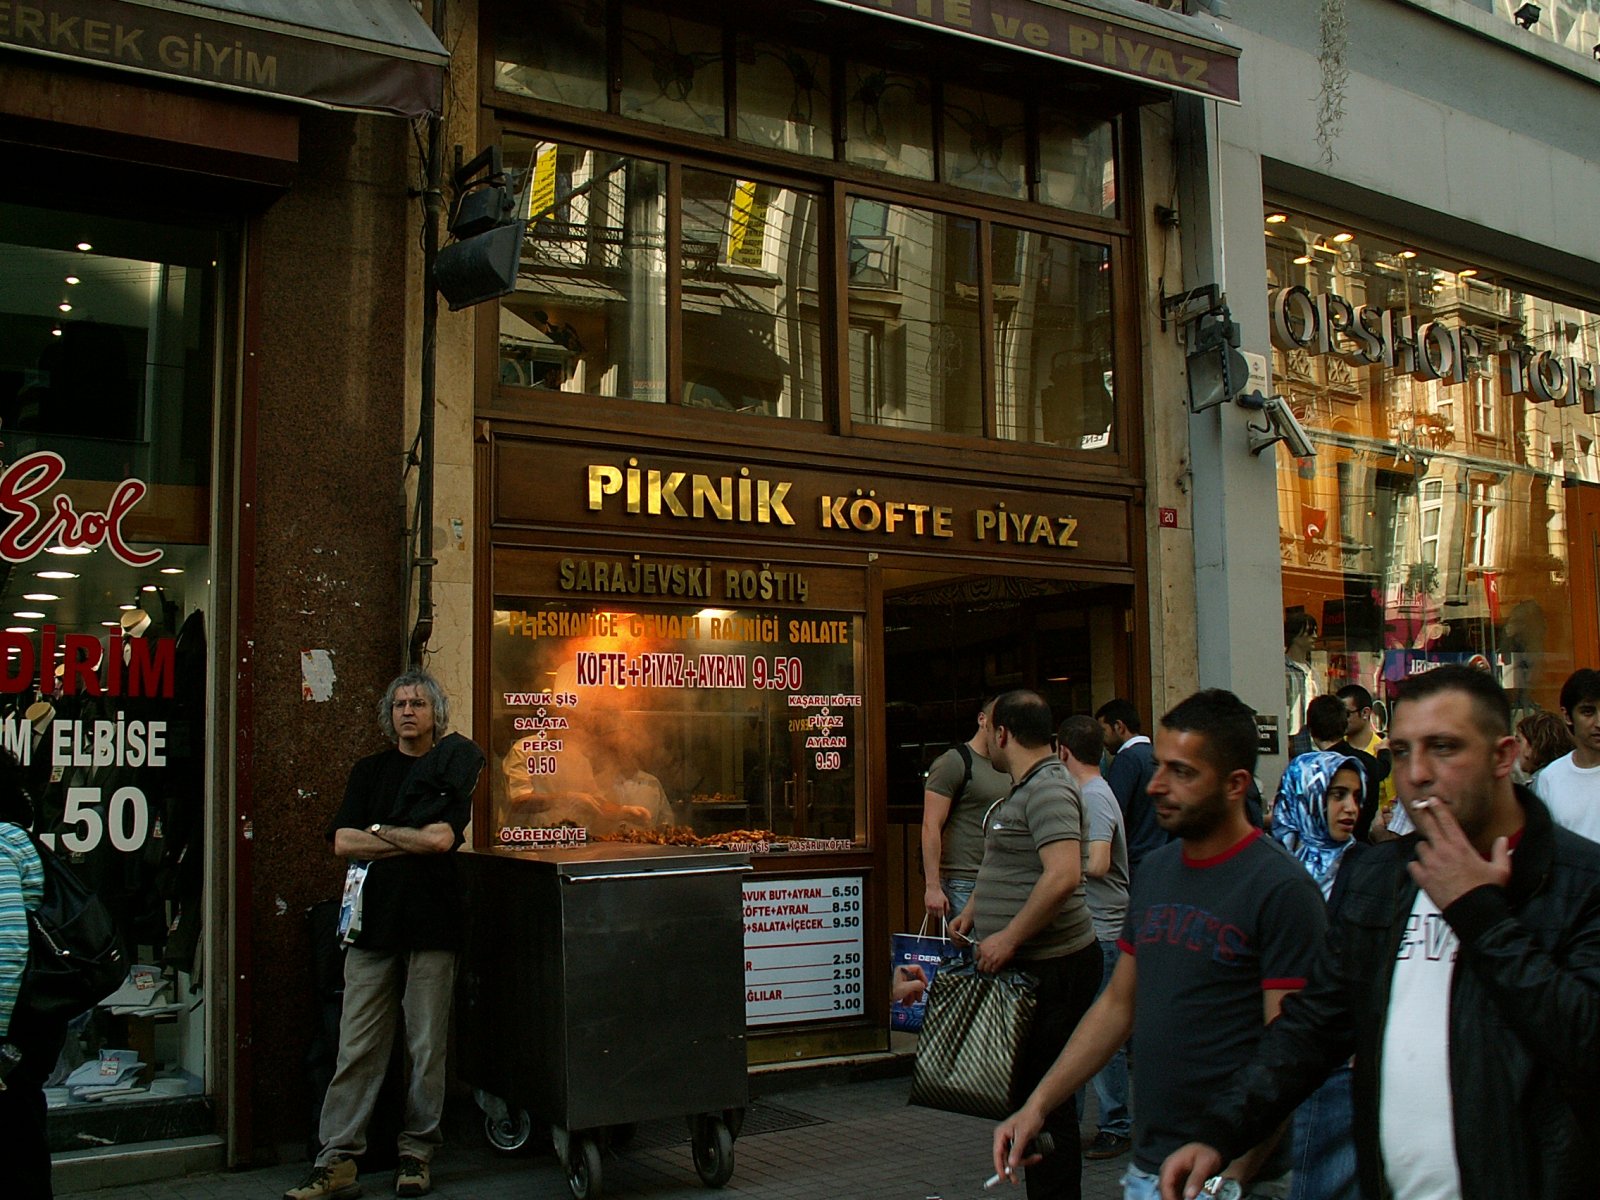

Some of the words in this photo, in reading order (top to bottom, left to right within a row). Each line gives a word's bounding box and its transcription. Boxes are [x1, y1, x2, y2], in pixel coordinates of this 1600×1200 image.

[880, 0, 973, 29] TE
[991, 12, 1050, 47] ve
[1069, 24, 1209, 89] PİYAZ
[157, 32, 278, 88] GİYİM
[586, 457, 796, 526] PİKNİK
[820, 488, 954, 539] KÖFTE
[976, 502, 1079, 548] PİYAZ
[1164, 512, 1174, 523] 20
[788, 619, 848, 644] SALATE
[752, 656, 803, 692] 9.50
[504, 692, 552, 706] TAVUK
[555, 692, 578, 708] ŞİŞ
[788, 695, 829, 709] KAŞARLI
[830, 694, 862, 706] KÖFTE
[514, 717, 569, 730] SALATA
[808, 714, 844, 728] PİYAZ
[0, 718, 32, 767] M
[51, 711, 168, 768] ELBİSE
[805, 736, 847, 749] AYRAN
[527, 756, 557, 776] 9.50
[815, 751, 841, 770] 9.50
[500, 825, 587, 843] ÖĞRENCİYE
[769, 888, 822, 901] BUT+AYRAN
[832, 886, 860, 897] 6.50
[832, 901, 860, 912] 8.50
[833, 917, 860, 928] 9.50
[833, 954, 861, 965] 2.50
[833, 968, 861, 980] 2.50
[745, 990, 782, 1003] ĞLILAR
[833, 983, 861, 995] 3.00
[833, 998, 861, 1010] 3.00
